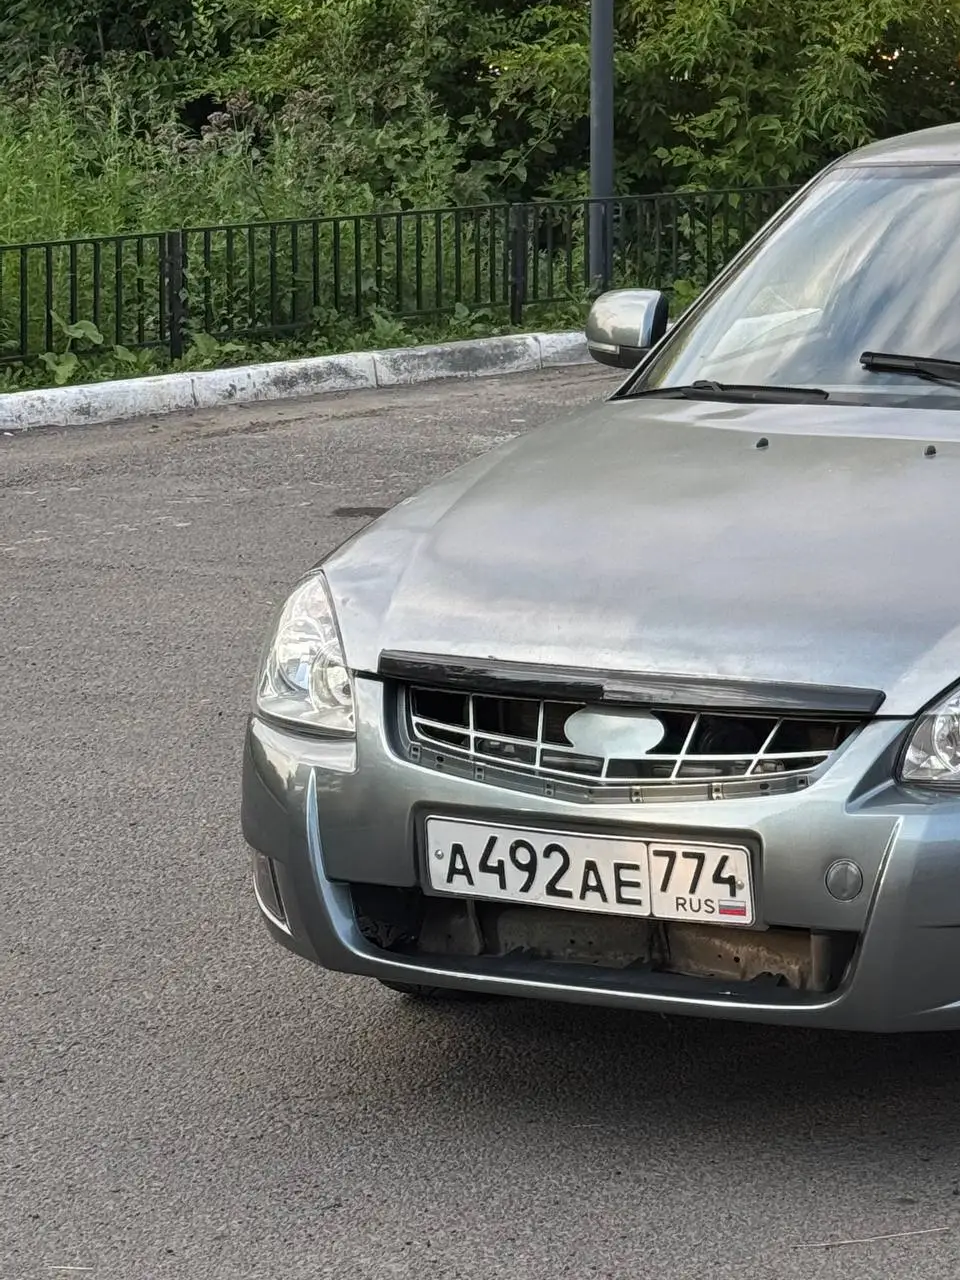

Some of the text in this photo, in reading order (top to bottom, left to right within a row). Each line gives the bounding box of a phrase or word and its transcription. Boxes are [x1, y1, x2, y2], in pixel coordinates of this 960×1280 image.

[446, 835, 737, 906] А492АЕ 774
[675, 896, 716, 915] RUS
